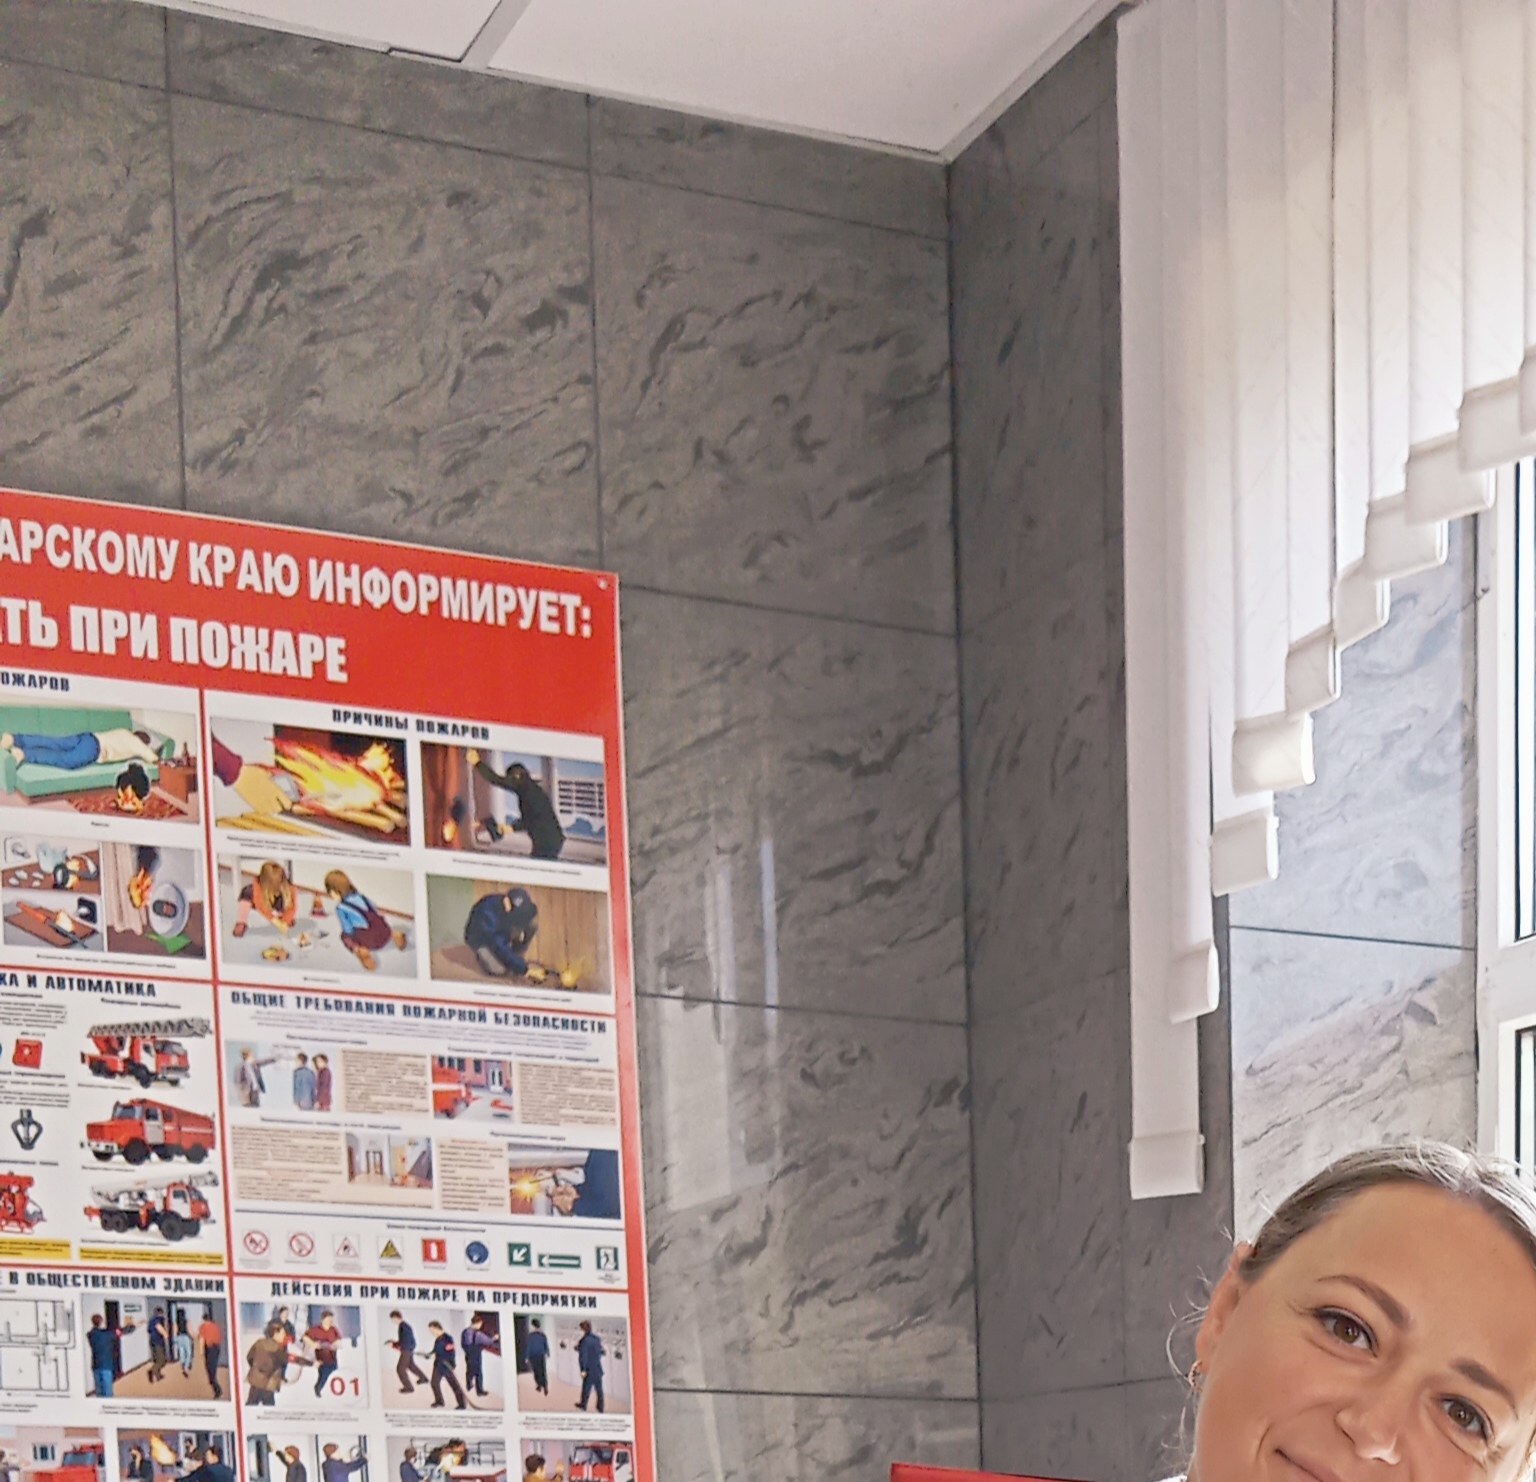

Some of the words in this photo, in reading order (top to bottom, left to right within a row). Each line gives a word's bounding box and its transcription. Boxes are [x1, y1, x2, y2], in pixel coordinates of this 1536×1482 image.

[188, 541, 300, 597] КРАЮ
[308, 557, 592, 638] ИНФОРМИРУЕТ:
[0, 596, 58, 648] ТЬ
[69, 604, 159, 660] ПРИ
[169, 616, 348, 683] ПОЖАРЕ
[331, 708, 409, 731] ПРИЧИНЫ
[415, 718, 490, 741] ПОЖАРОВ
[26, 974, 38, 988] И
[45, 975, 157, 998] АВТОМАТИКА
[231, 989, 287, 1010] ОБЩИЕ
[295, 994, 396, 1017] ТРЕБОВАНИЯ
[402, 1002, 487, 1025] ПОЖАРНОЙ
[493, 1013, 607, 1035] БЕЗОПАСНОСТИ
[9, 1271, 20, 1286] В
[26, 1271, 157, 1291] ОБЩЕСТВЕННОМ
[163, 1277, 225, 1294] ЗДАНИИ
[271, 1280, 353, 1299] ДЕЙСТВИЯ
[359, 1284, 391, 1302] ПРИ
[396, 1286, 459, 1304] ПОЖАРЕ
[466, 1289, 486, 1305] НА
[492, 1290, 598, 1310] ПРЕДПРИЯТИИ
[329, 1376, 361, 1397] 01
